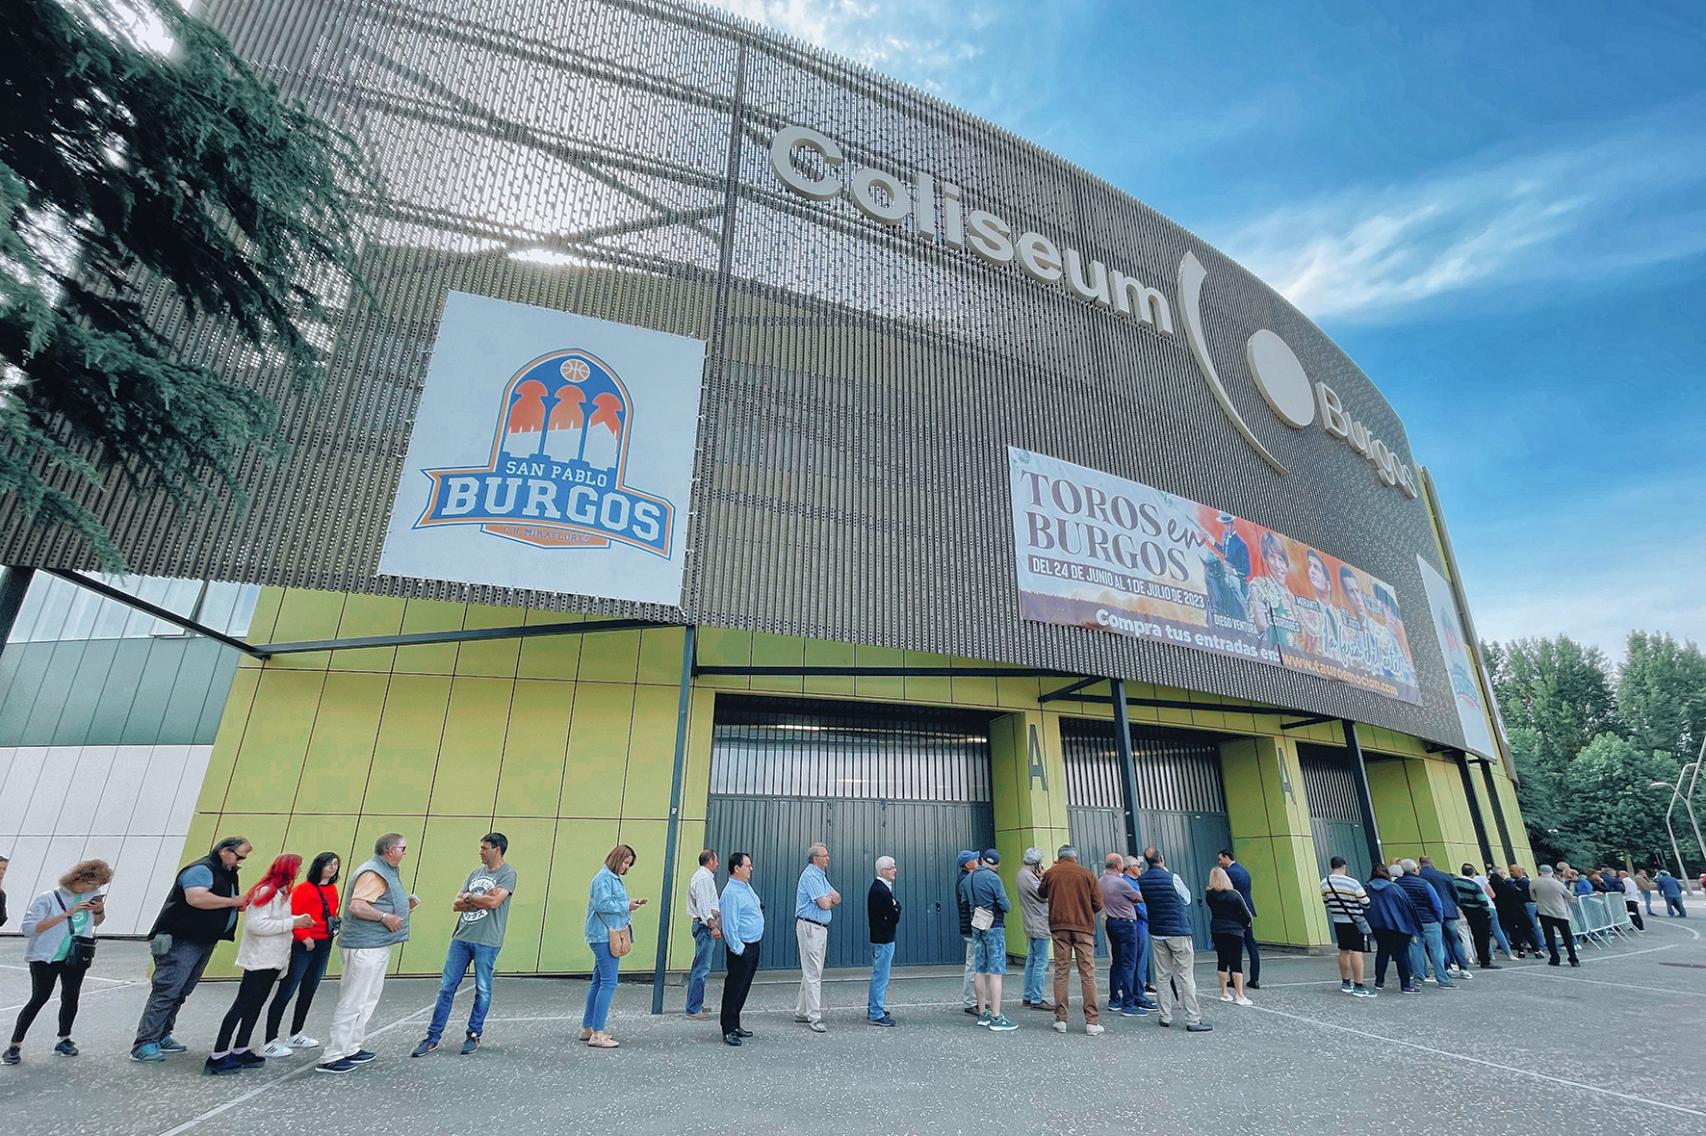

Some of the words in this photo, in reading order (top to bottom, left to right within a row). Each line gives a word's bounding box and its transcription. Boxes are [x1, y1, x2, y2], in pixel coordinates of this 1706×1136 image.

[770, 126, 1175, 336] Coliseum
[506, 460, 545, 478] SAN
[551, 465, 608, 487] PABLO
[1314, 381, 1418, 499] Burgos
[441, 477, 661, 542] BURGOS
[1021, 470, 1162, 537] TOROS
[1168, 518, 1206, 550] en
[1024, 511, 1189, 582] BURGOS
[1032, 557, 1053, 575] DEL
[1054, 562, 1069, 579] 24
[1071, 565, 1085, 581] DE
[1086, 568, 1114, 586] JUNIO
[1114, 576, 1126, 590] AL
[1126, 578, 1132, 592] 1
[1132, 580, 1146, 595] DE
[1146, 582, 1171, 600] JULIO
[1171, 589, 1184, 604] DE
[1183, 591, 1205, 609] 2023
[1095, 609, 1163, 638] Compra
[1165, 624, 1192, 644] tus
[1194, 632, 1259, 660] entradas
[1261, 647, 1280, 662] en:
[1284, 654, 1399, 696] www.tauroemocion.com
[1214, 614, 1233, 629] DIEGO
[1029, 723, 1049, 791] A
[1277, 747, 1297, 805] A
